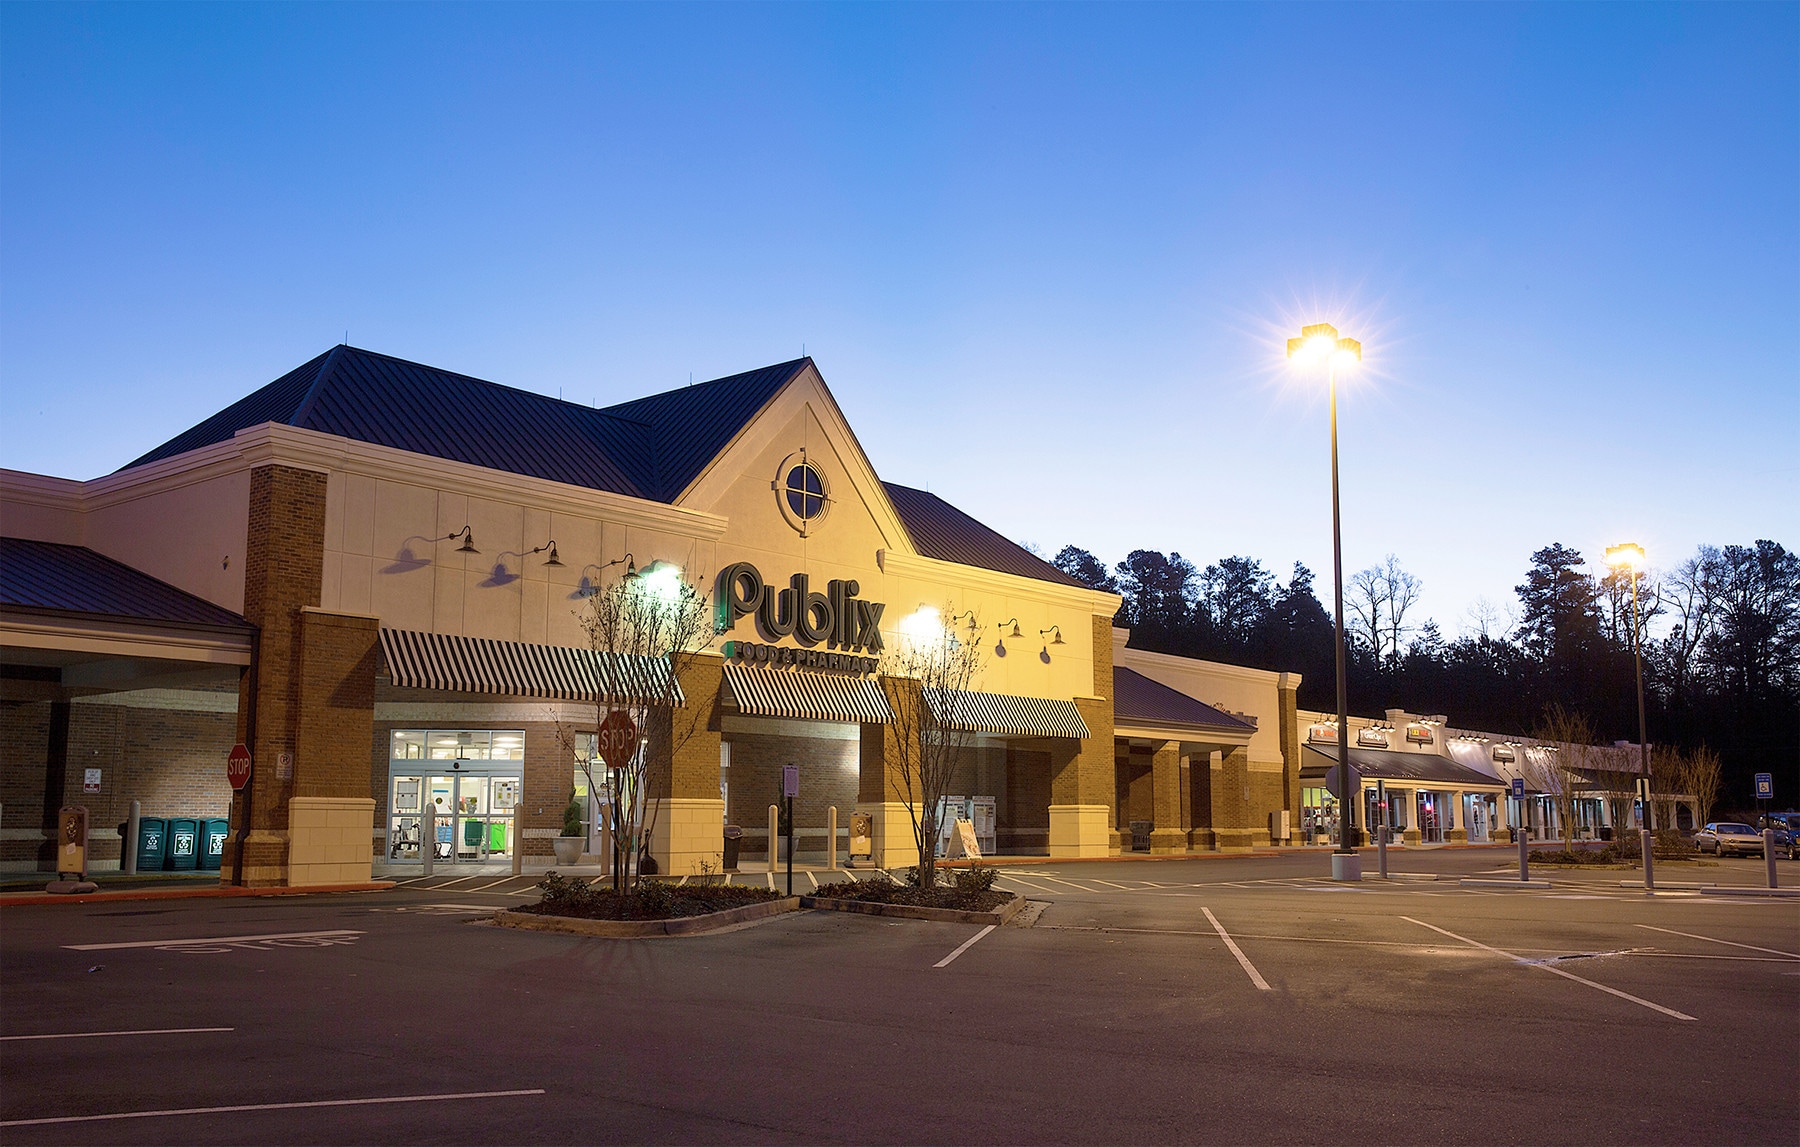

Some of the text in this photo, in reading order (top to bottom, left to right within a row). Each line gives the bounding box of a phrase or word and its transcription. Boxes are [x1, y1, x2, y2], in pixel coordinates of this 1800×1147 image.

[714, 561, 886, 652] Publix
[724, 641, 880, 675] FOOD & PHARMACY
[228, 757, 250, 776] STOP
[154, 936, 360, 954] STOP
